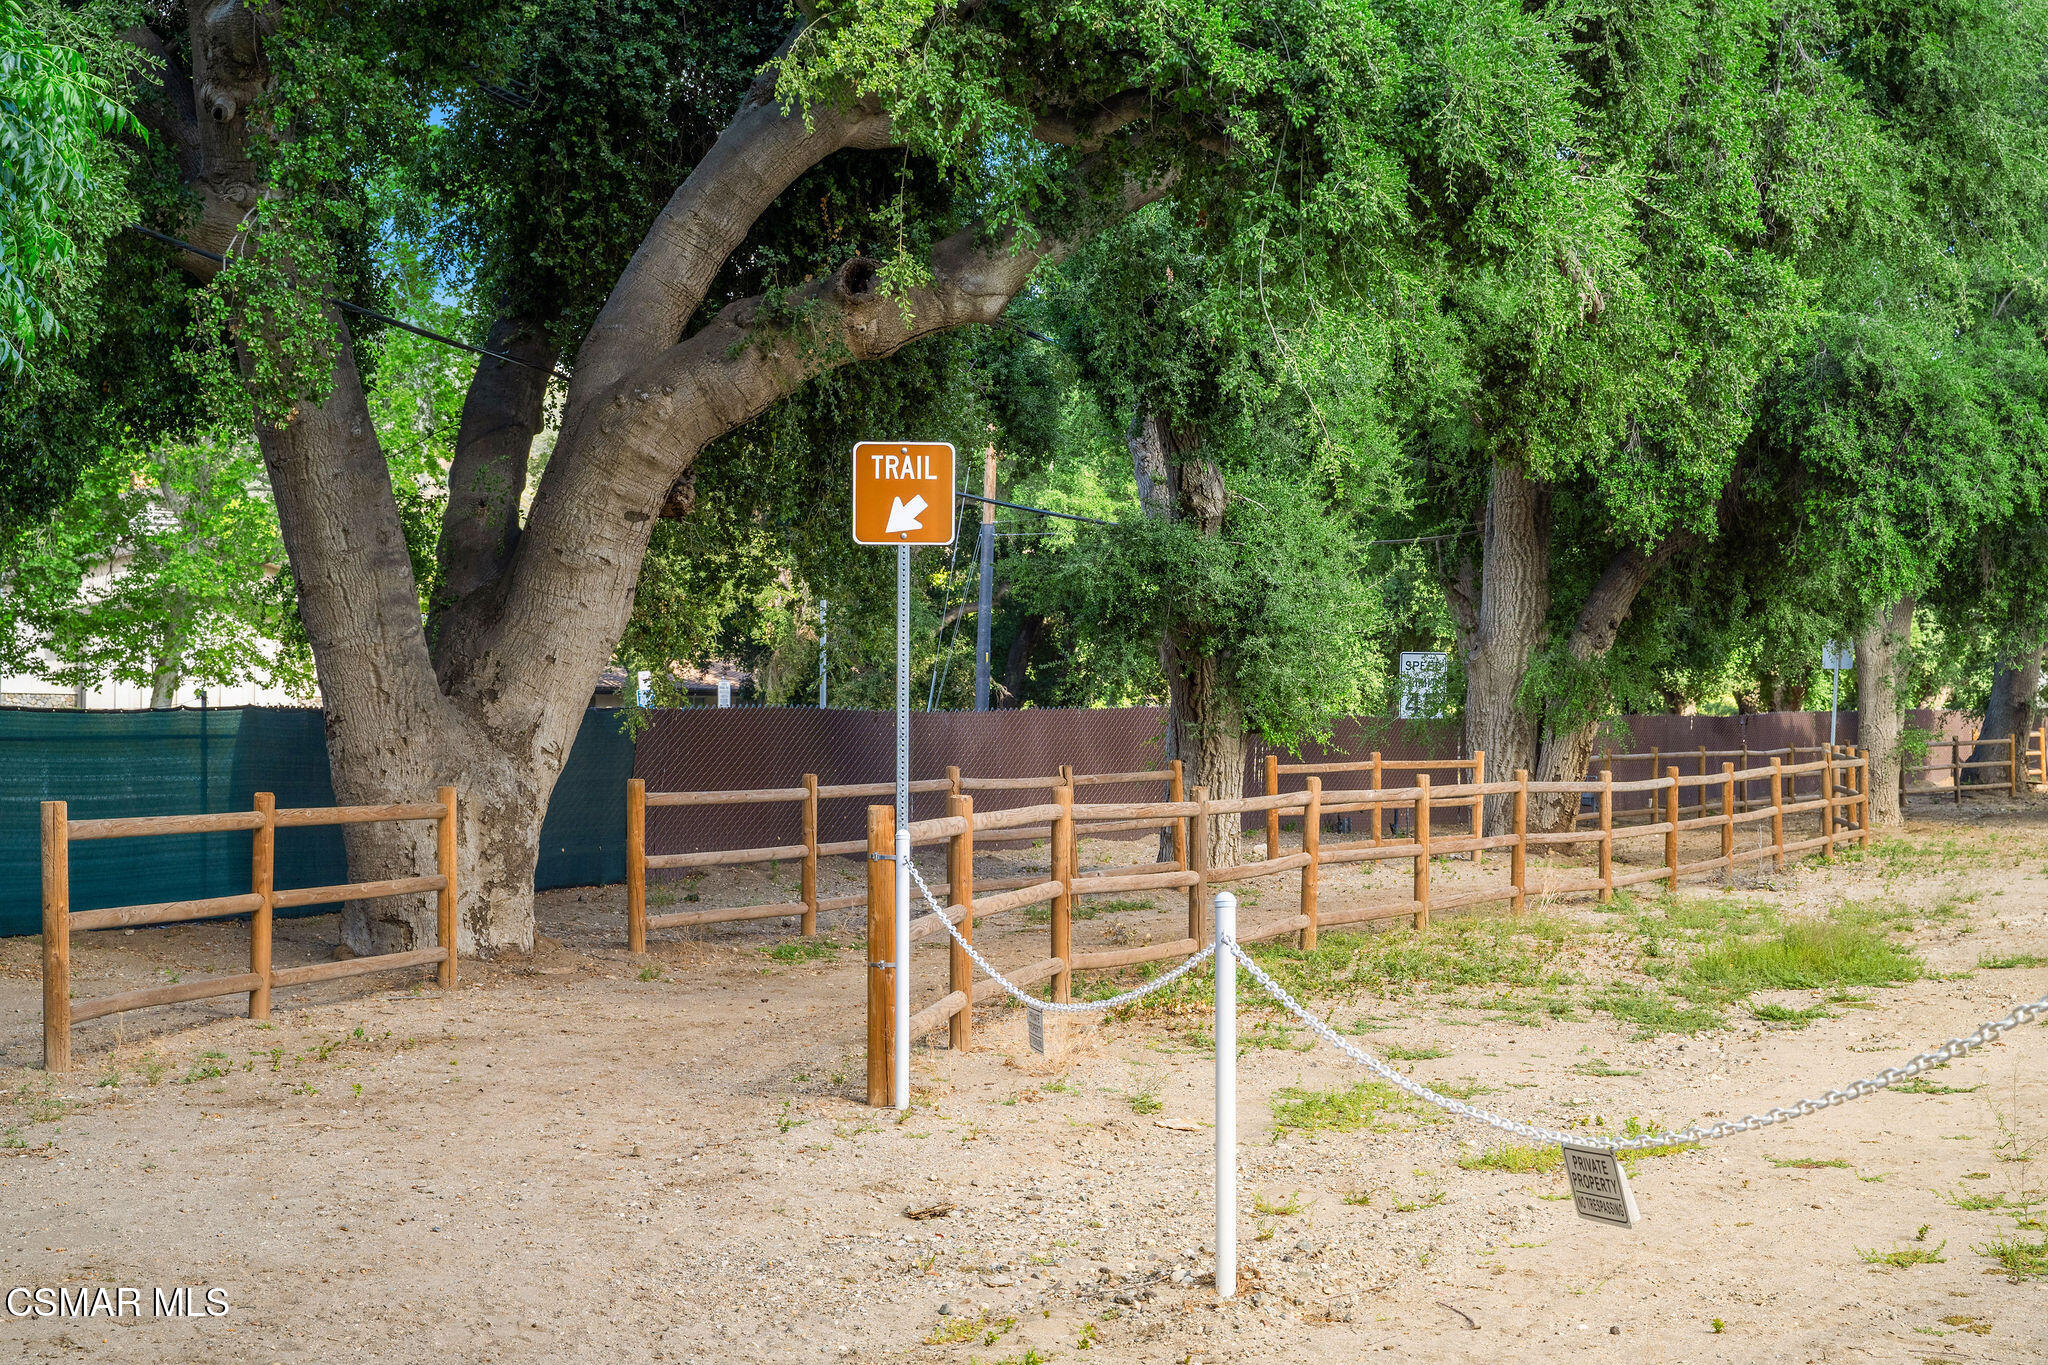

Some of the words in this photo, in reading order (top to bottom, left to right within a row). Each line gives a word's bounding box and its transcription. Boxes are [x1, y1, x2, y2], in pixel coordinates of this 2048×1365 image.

[871, 455, 938, 480] TRAIL
[1405, 660, 1442, 671] SPE
[1572, 1155, 1609, 1175] PRIVATE
[1571, 1172, 1617, 1194] PROPERTY
[1577, 1195, 1586, 1208] NO
[1585, 1197, 1624, 1217] TRESPASSING
